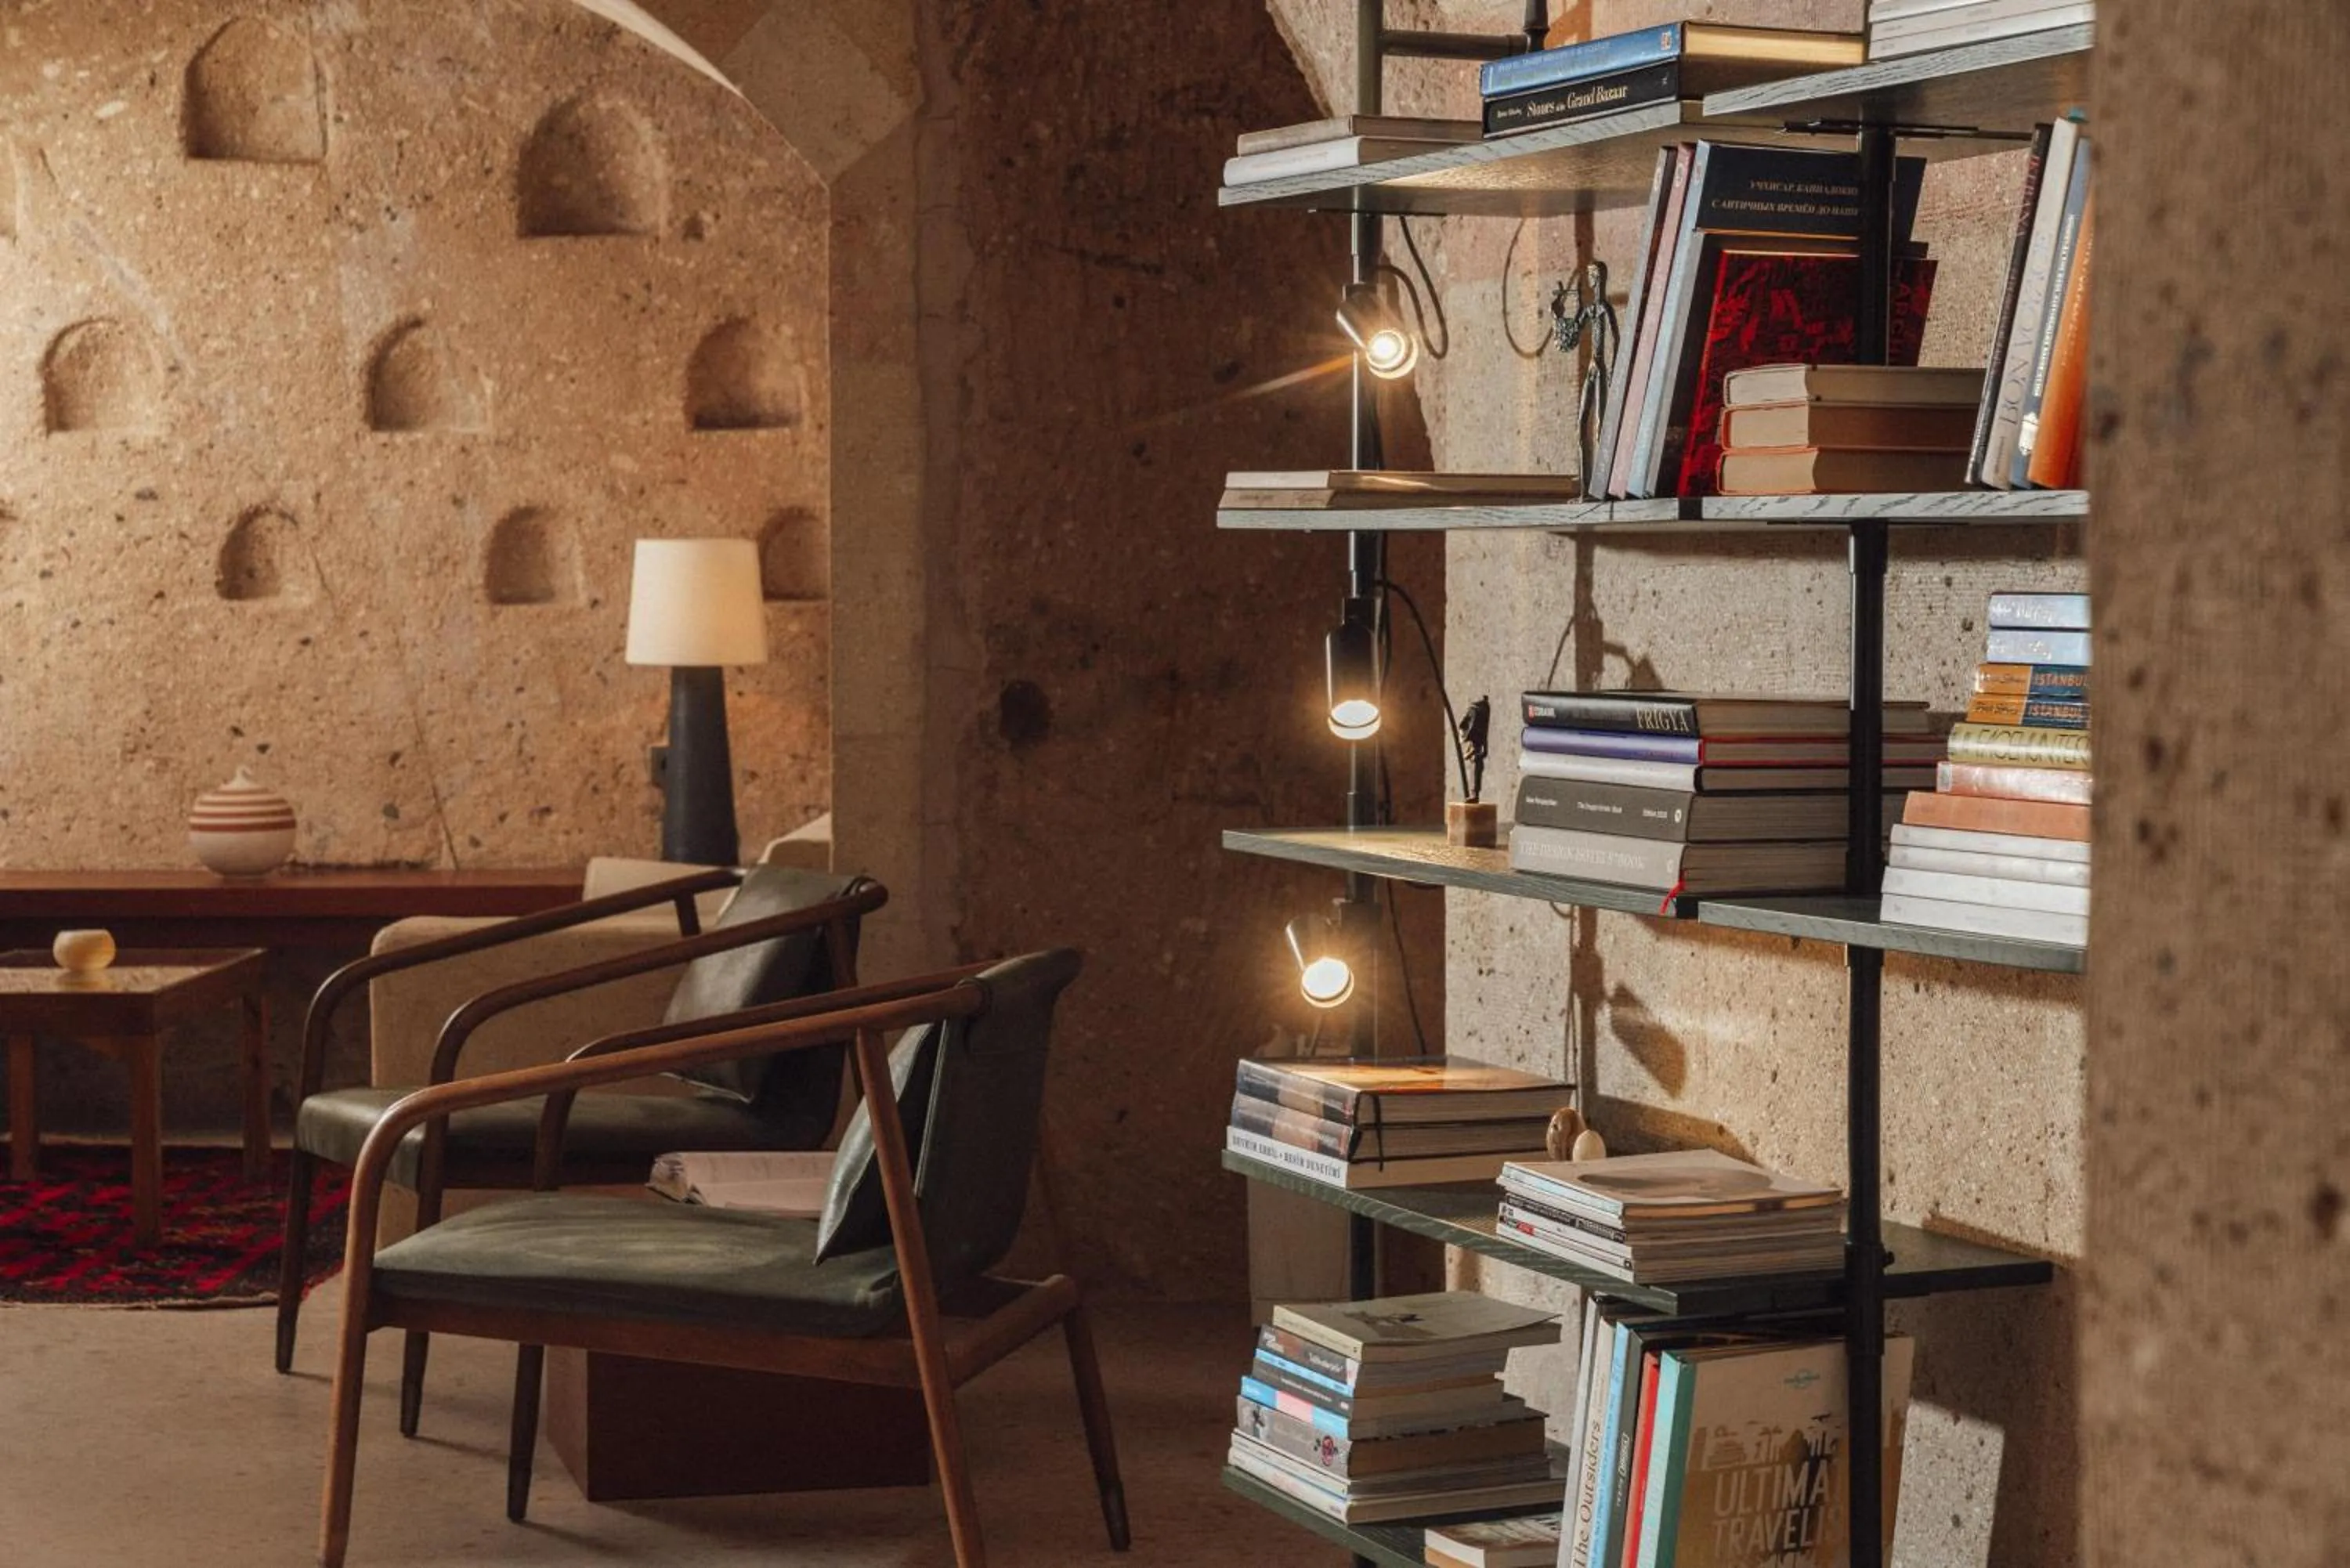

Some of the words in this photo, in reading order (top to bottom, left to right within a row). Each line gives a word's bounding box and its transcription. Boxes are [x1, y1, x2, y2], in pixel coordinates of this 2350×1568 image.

[1567, 87, 1596, 108] Grand
[1596, 84, 1628, 107] Bazaar
[1998, 360, 2030, 426] BON
[1578, 1420, 1601, 1524] Outsiders
[1571, 1529, 1590, 1568] The
